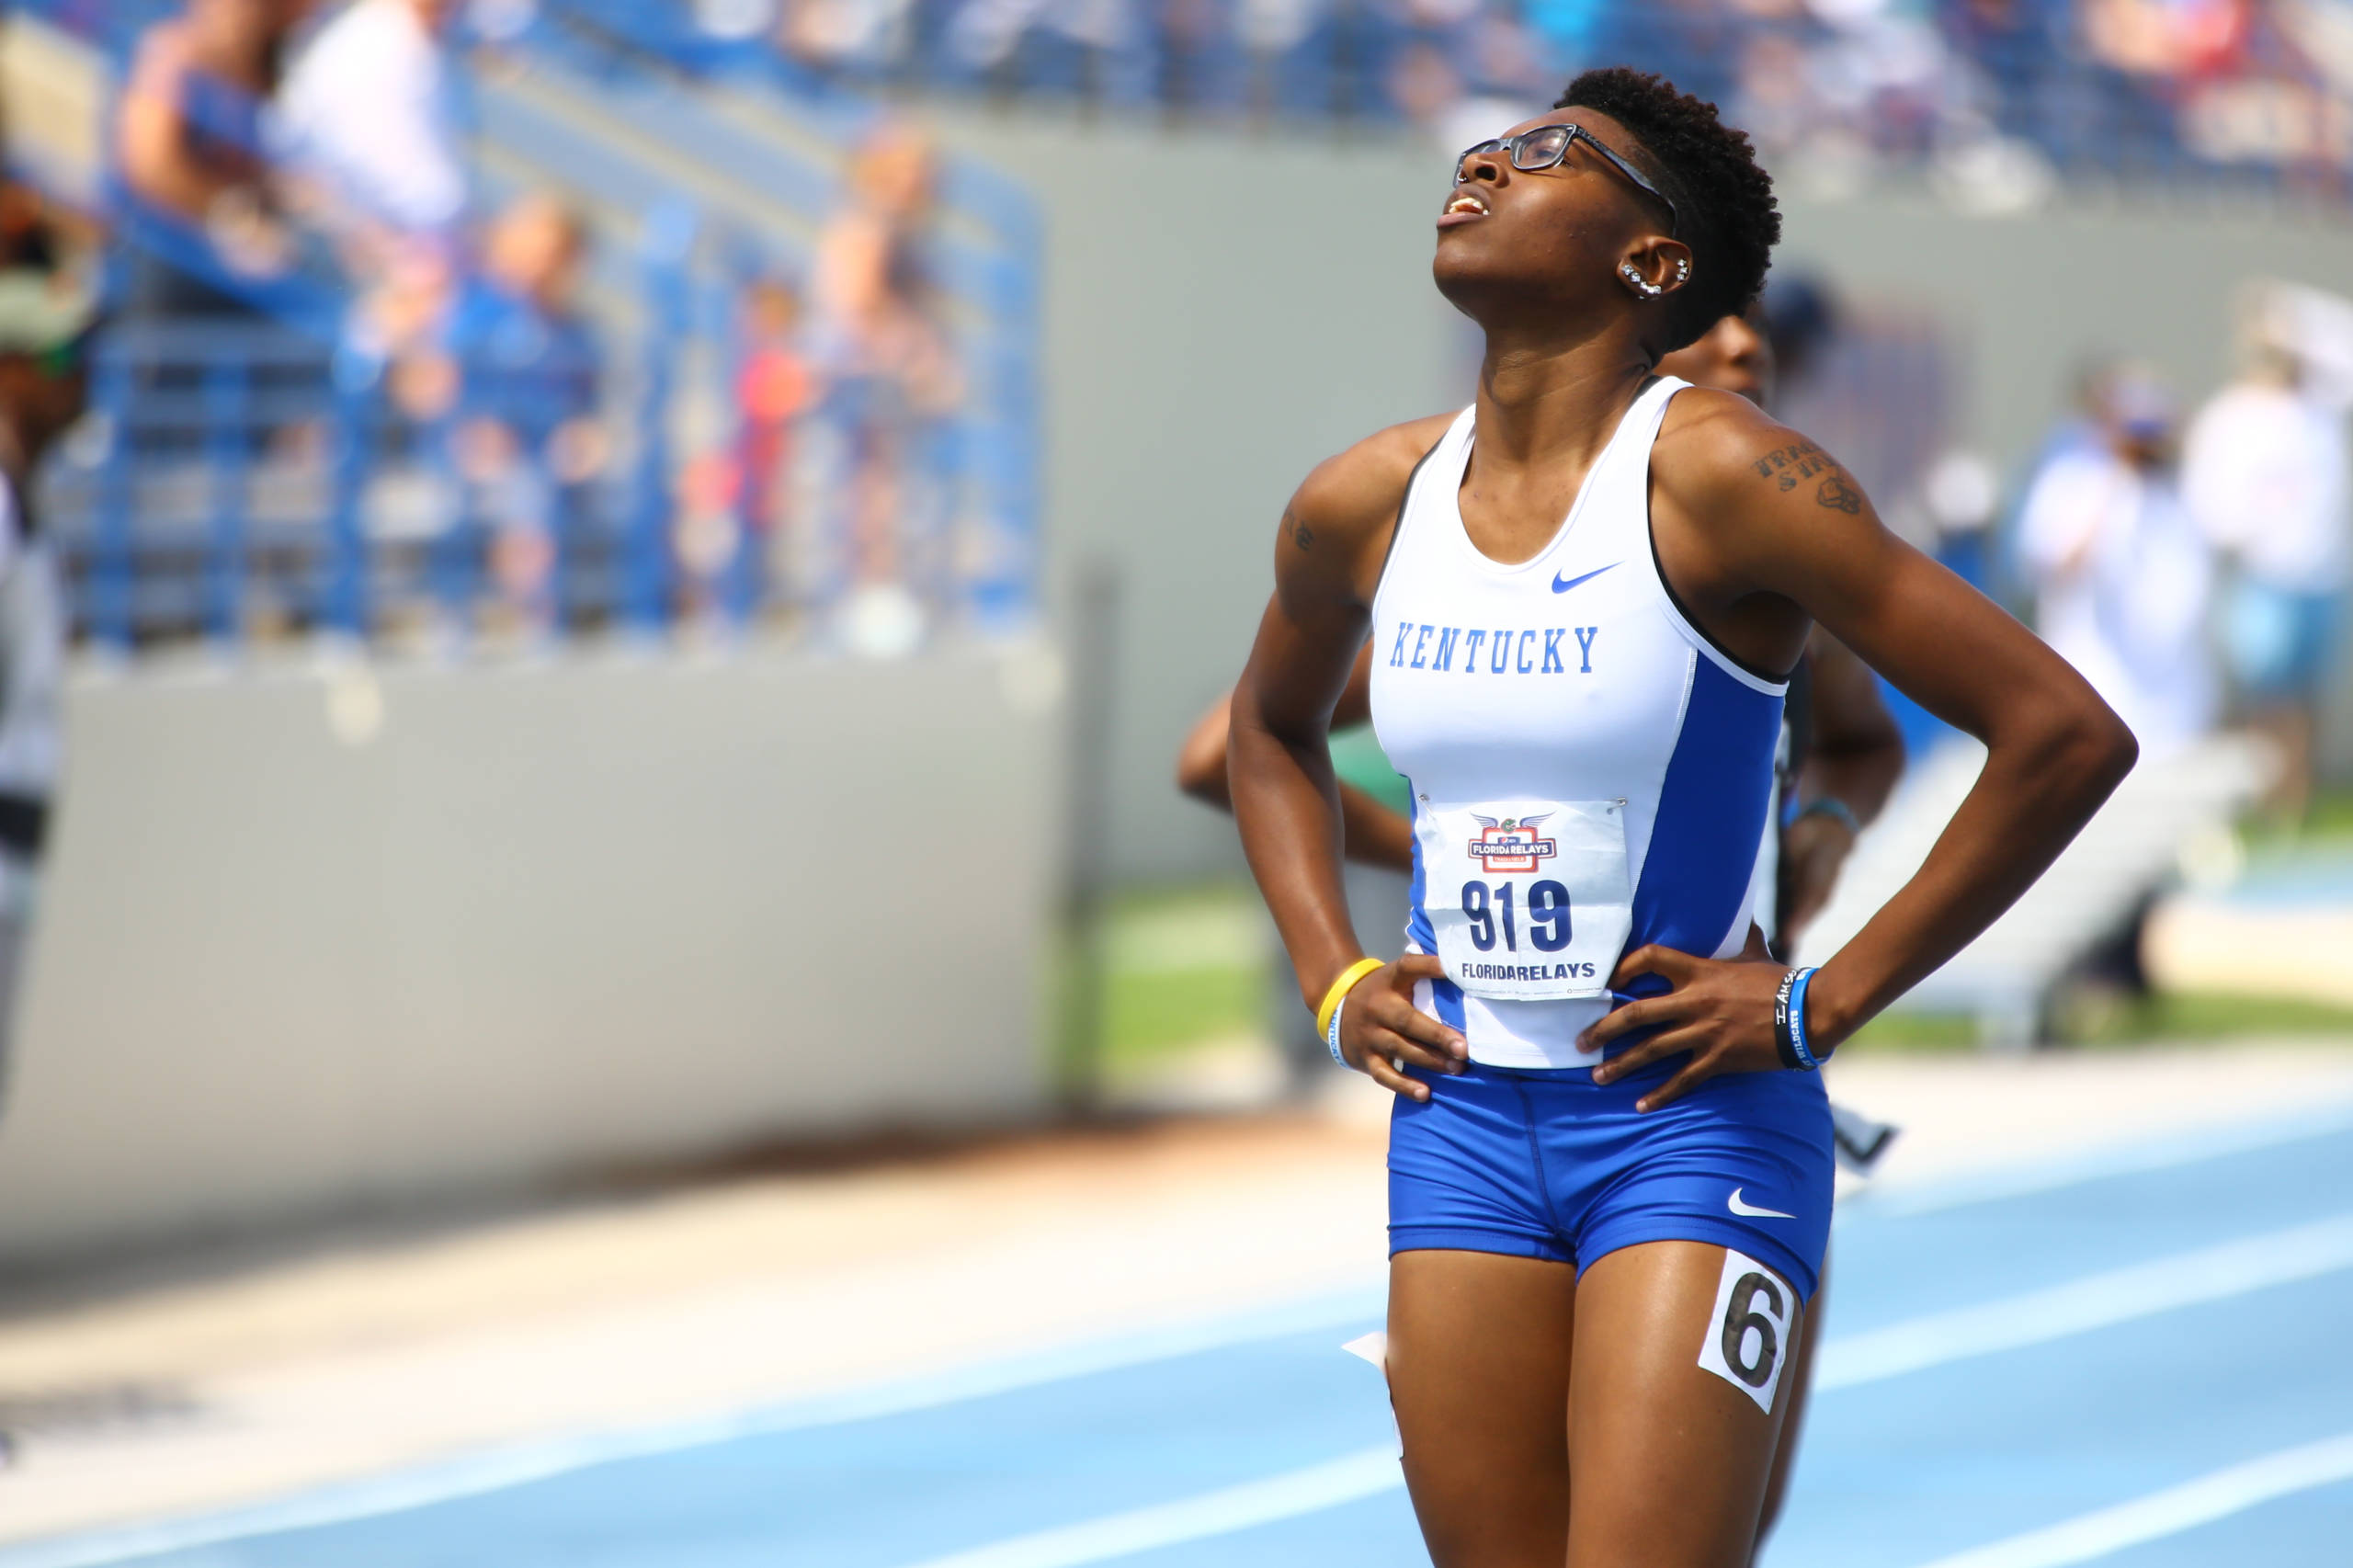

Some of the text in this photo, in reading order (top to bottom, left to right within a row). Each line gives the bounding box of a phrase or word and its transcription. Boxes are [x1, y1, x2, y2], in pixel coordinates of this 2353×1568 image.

[1389, 621, 1598, 675] KENTUCKY
[1461, 880, 1573, 953] 919
[1790, 1009, 1806, 1059] WILDCATS
[1722, 1271, 1784, 1389] 6
